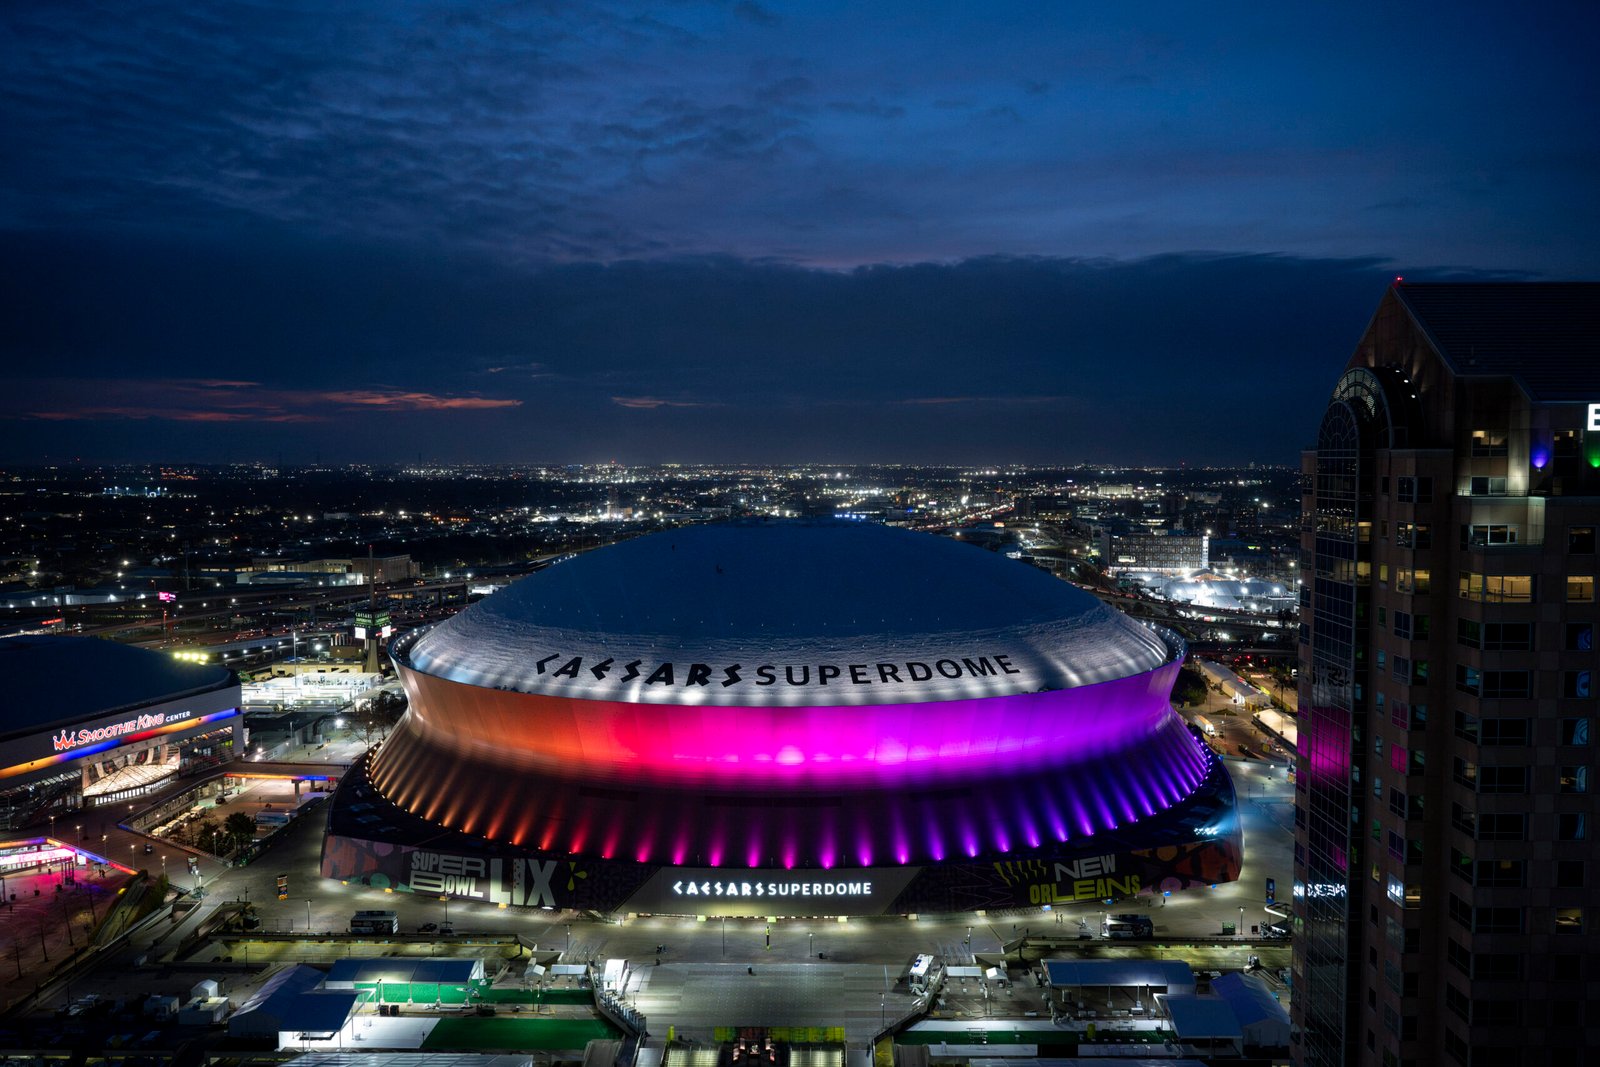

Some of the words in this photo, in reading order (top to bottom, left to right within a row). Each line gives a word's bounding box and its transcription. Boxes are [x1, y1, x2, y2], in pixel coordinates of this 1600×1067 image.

[536, 653, 742, 688] CAESARS
[755, 654, 1020, 686] SUPERDOME
[78, 720, 136, 745] SMOOTHIE
[165, 711, 191, 722] CENTER
[411, 851, 486, 877] SUPER
[1054, 854, 1116, 882] NEW
[410, 870, 483, 898] BOWL
[490, 858, 558, 906] LIX
[673, 880, 765, 896] CAESARS
[768, 882, 872, 896] SUPERDOME
[1030, 874, 1141, 904] ORLEANS
